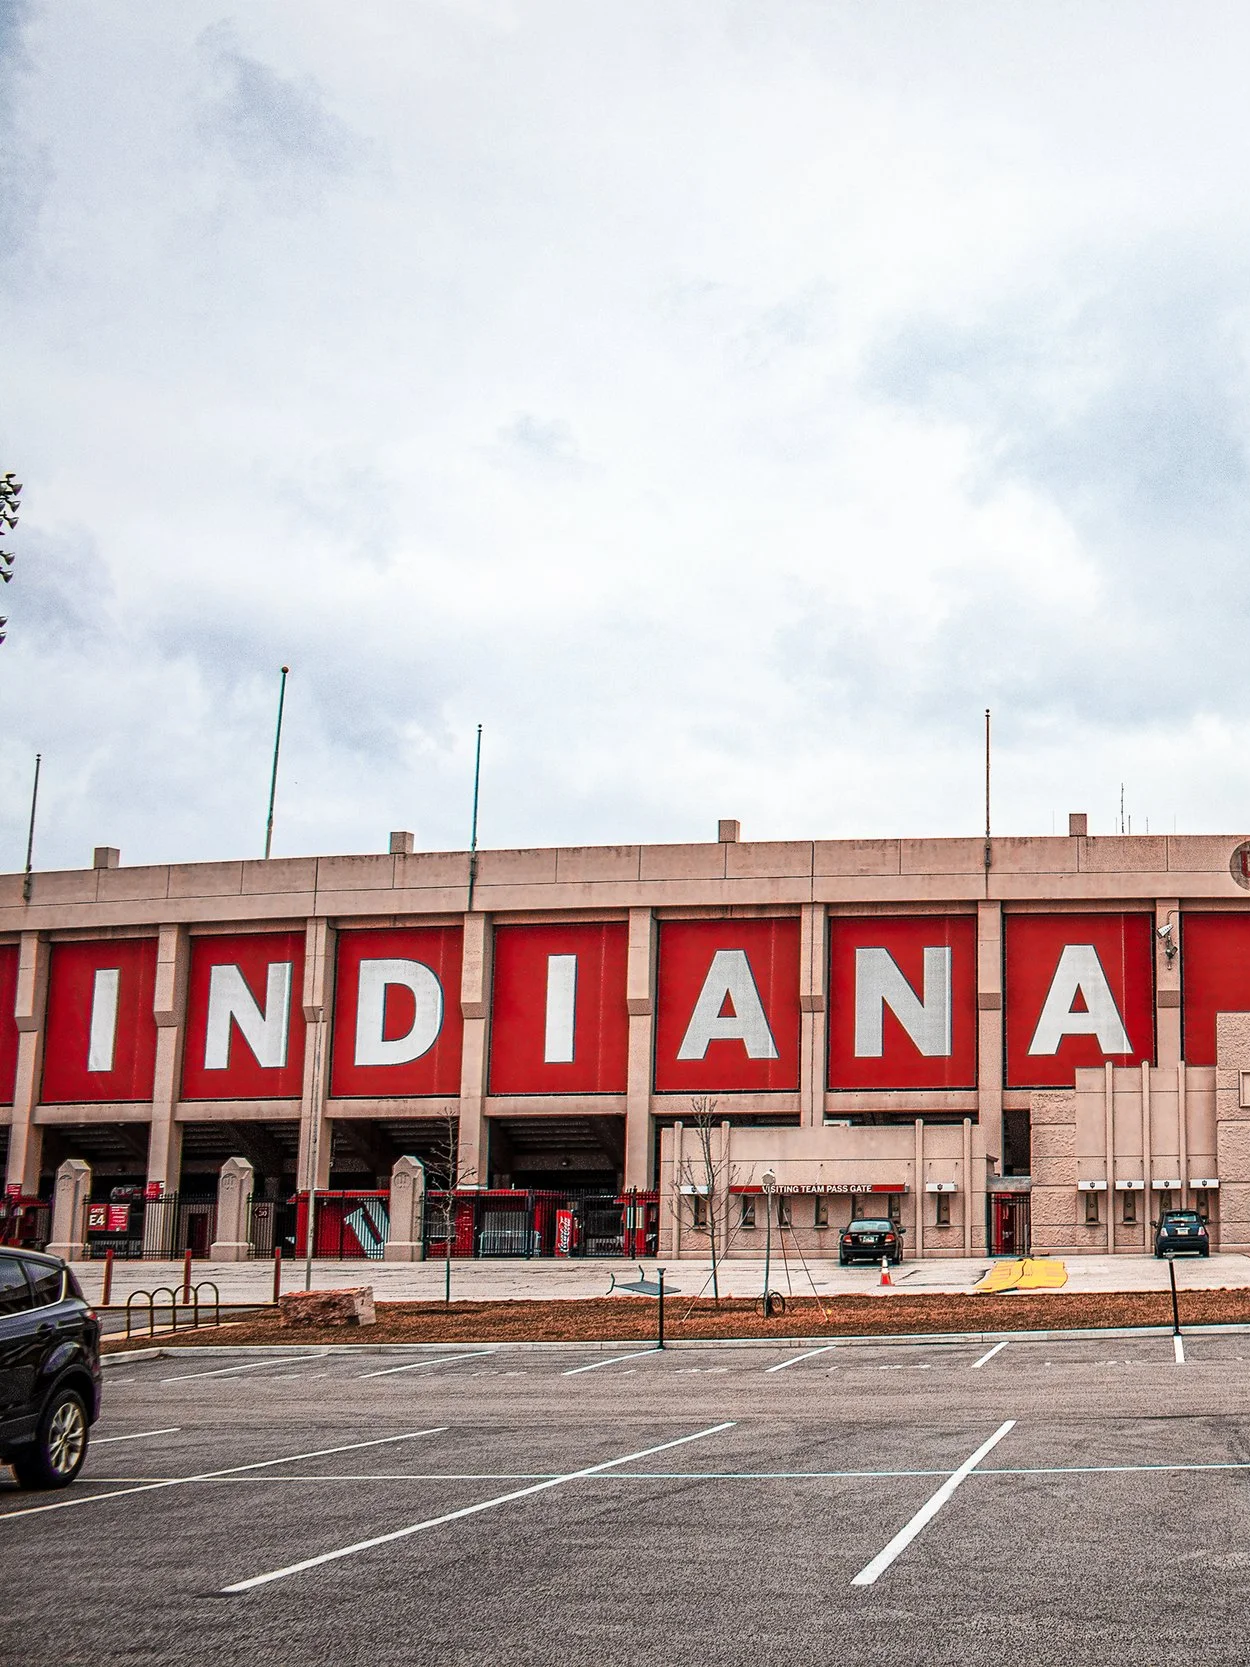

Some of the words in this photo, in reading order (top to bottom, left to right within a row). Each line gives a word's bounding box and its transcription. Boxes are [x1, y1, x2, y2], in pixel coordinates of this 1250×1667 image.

[87, 944, 1133, 1072] INDIANA
[801, 1185, 824, 1193] TEAM
[827, 1185, 848, 1193] PASS
[850, 1184, 872, 1192] GATE
[89, 1214, 106, 1226] E4
